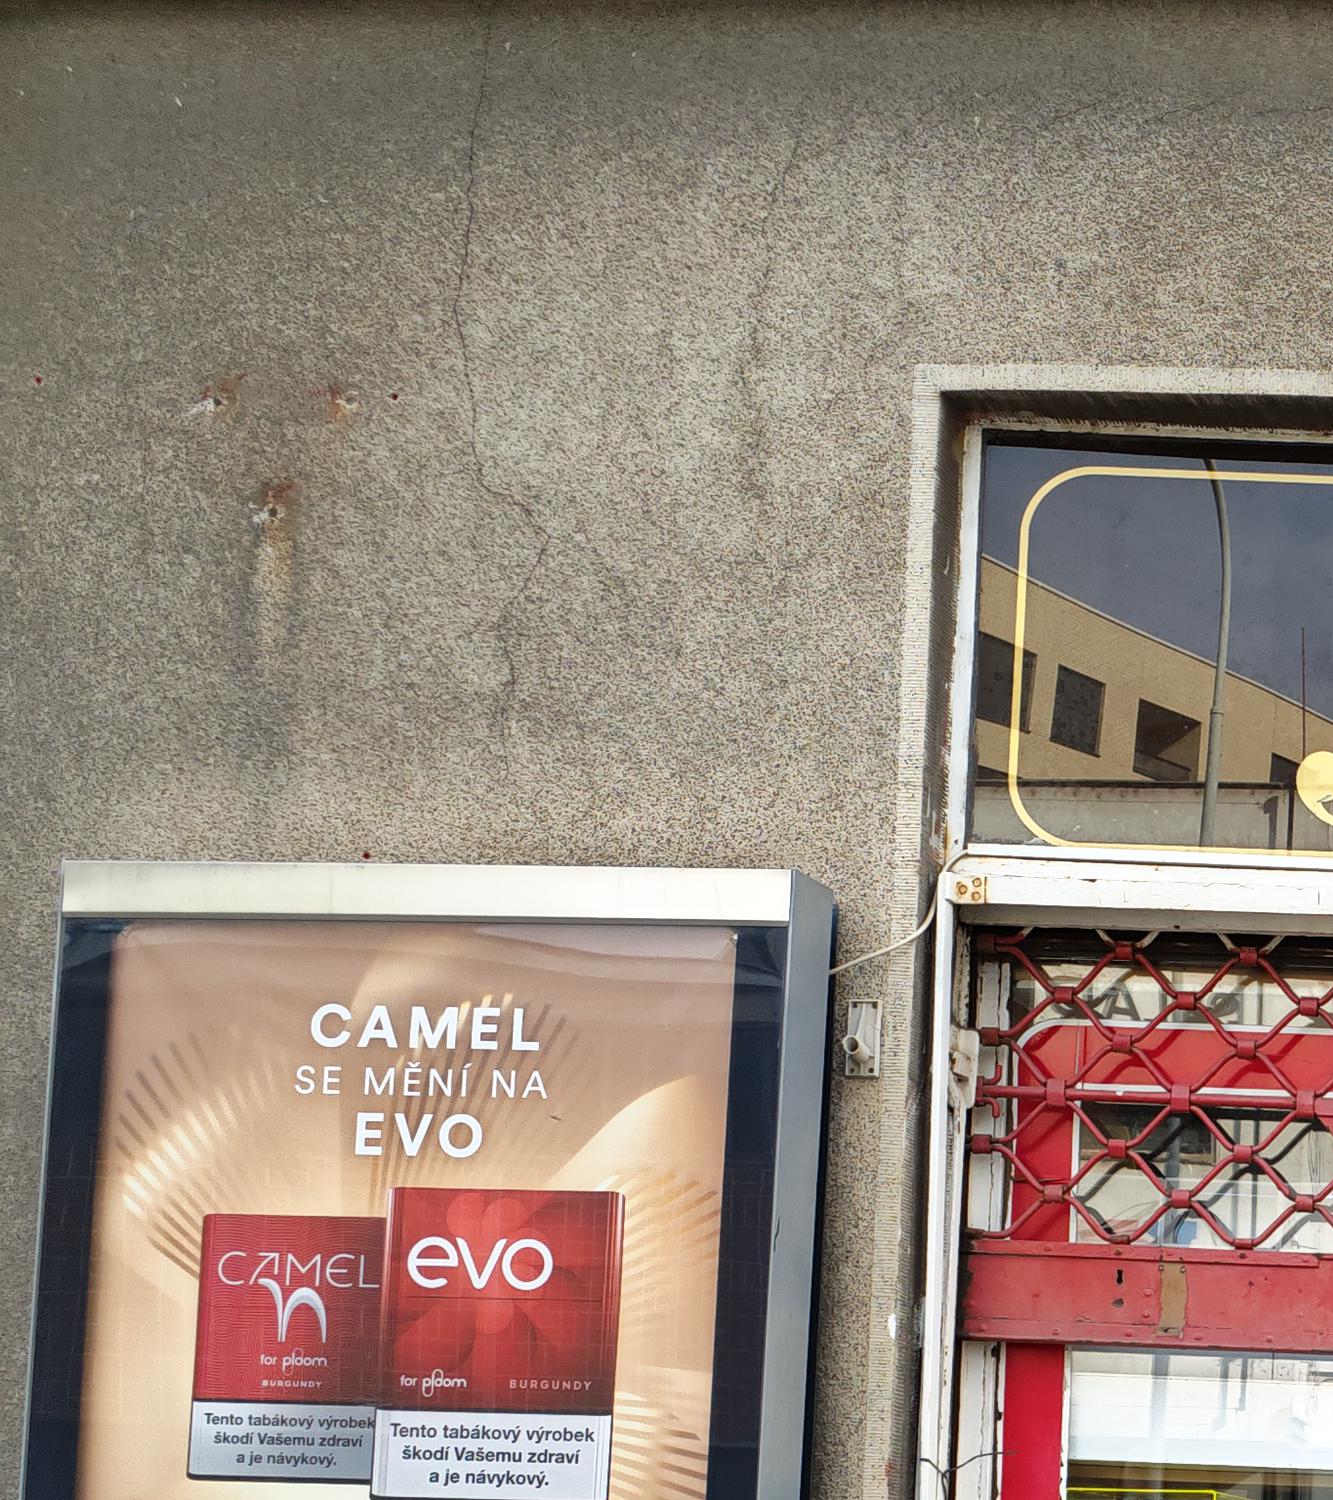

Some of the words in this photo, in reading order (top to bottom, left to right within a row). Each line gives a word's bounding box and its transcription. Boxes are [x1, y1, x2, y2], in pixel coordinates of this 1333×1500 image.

[310, 1003, 540, 1052] CAMEL
[295, 1066, 341, 1095] SE
[364, 1060, 470, 1098] MĚNÍ
[491, 1069, 548, 1099] NA
[353, 1112, 484, 1158] EVO
[218, 1252, 379, 1289] CAMEL
[407, 1236, 553, 1290] evo
[260, 1354, 277, 1365] for
[282, 1348, 327, 1375] ploom
[262, 1380, 322, 1388] BURGUNDY
[400, 1375, 417, 1387] for
[422, 1369, 467, 1397] ploom
[509, 1379, 592, 1391] BURGUNDY
[204, 1413, 244, 1426] Tento
[247, 1413, 314, 1430] tabákový
[214, 1431, 254, 1446] škodí
[257, 1432, 315, 1447] Vašemu
[319, 1434, 363, 1447] zdraví
[390, 1423, 437, 1439] Tento
[442, 1423, 520, 1443] tabákový
[526, 1426, 595, 1443] výrobek
[236, 1454, 245, 1465] a
[248, 1452, 262, 1467] je
[267, 1450, 337, 1468] návykový.
[402, 1445, 449, 1462] škodí
[453, 1446, 523, 1463] Vašemu
[527, 1447, 580, 1465] zdraví
[429, 1471, 439, 1484] a
[444, 1469, 460, 1486] je
[465, 1468, 549, 1488] návykový.
